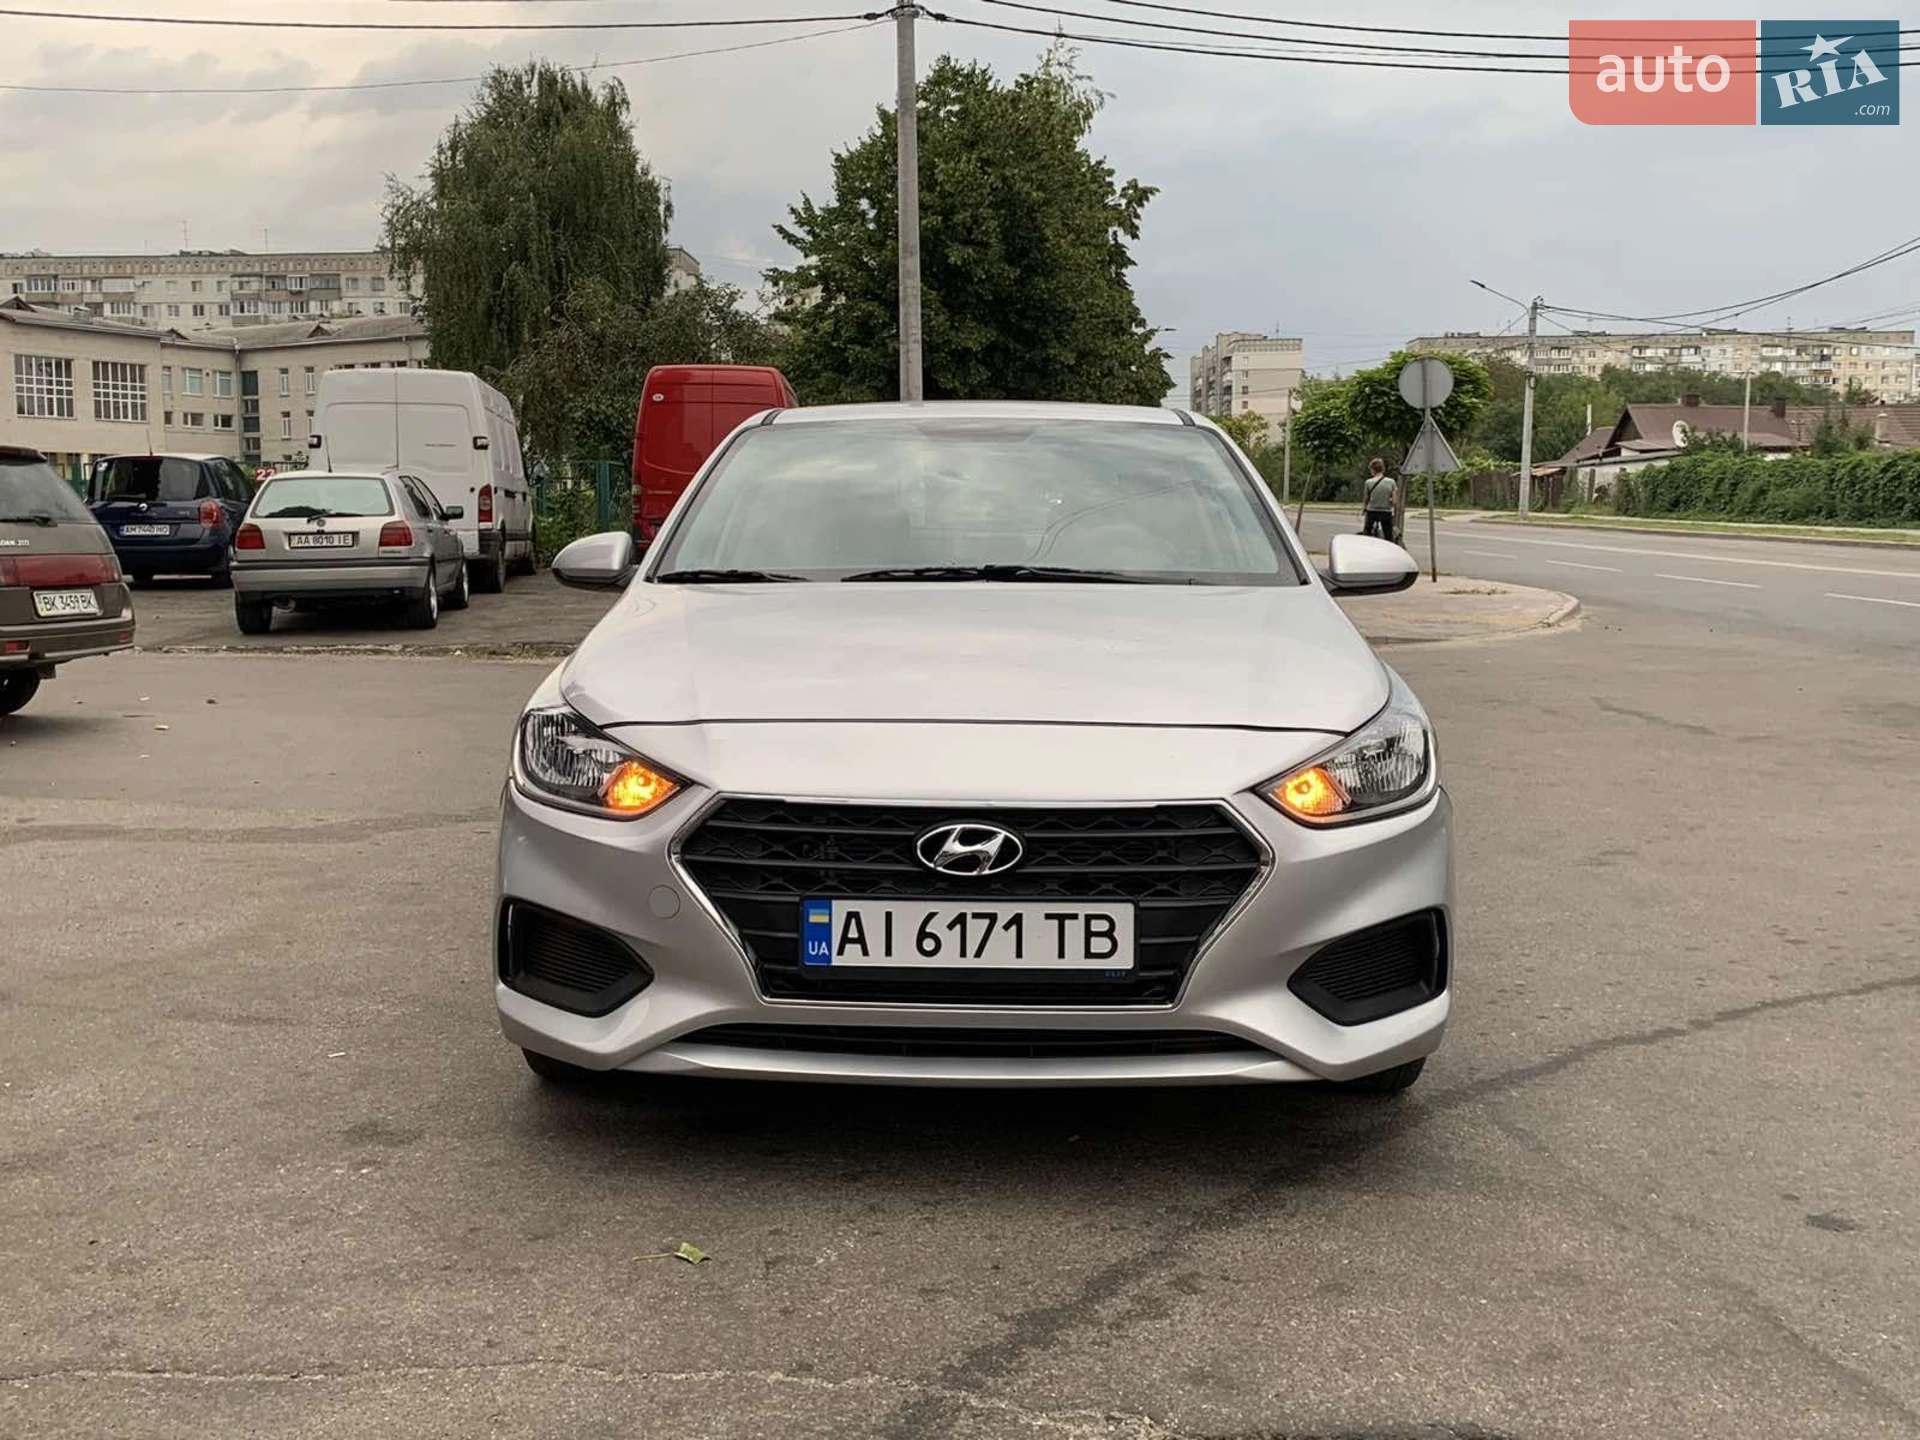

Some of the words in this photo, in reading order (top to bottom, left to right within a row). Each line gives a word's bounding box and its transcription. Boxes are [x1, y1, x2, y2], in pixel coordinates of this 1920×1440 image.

[296, 536, 310, 545] AA
[312, 535, 334, 545] 8010
[338, 535, 350, 544] IE
[42, 595, 60, 611] BK
[79, 594, 96, 609] BK
[836, 910, 894, 957] AI
[915, 911, 1023, 959] 6171
[1044, 912, 1119, 960] TB
[808, 940, 829, 955] UA
